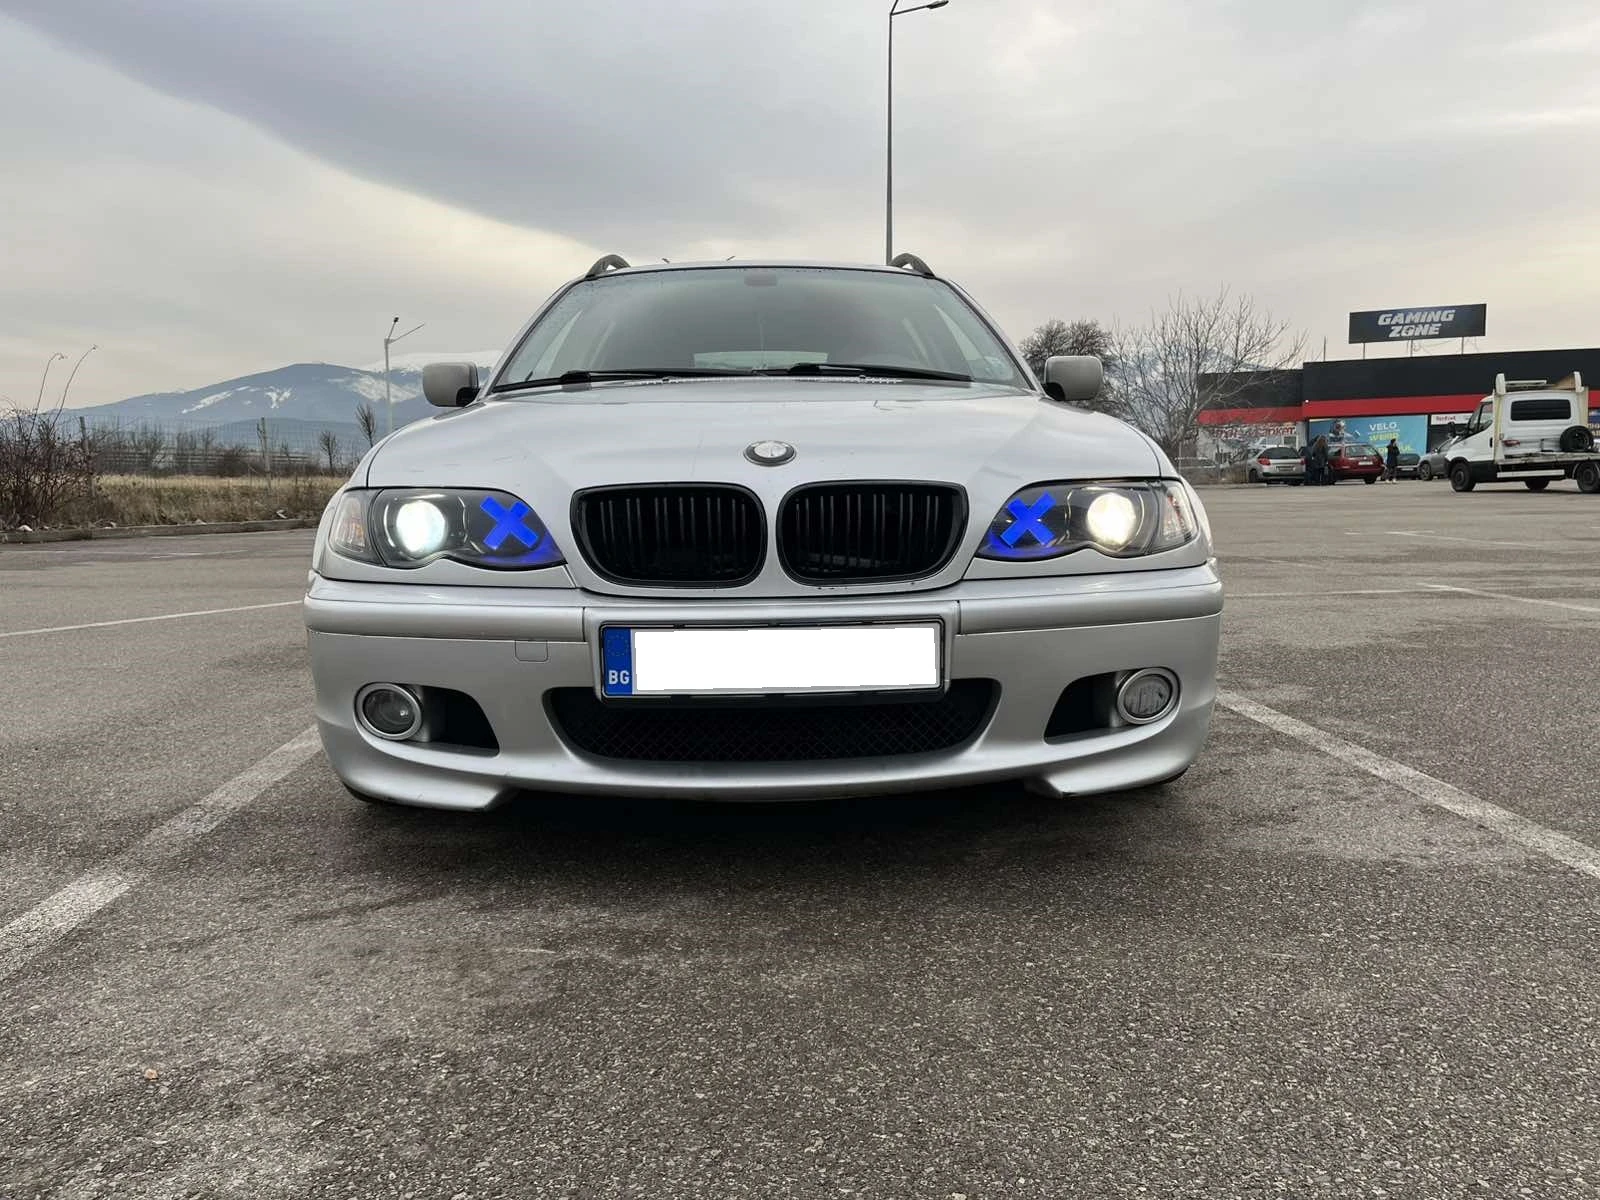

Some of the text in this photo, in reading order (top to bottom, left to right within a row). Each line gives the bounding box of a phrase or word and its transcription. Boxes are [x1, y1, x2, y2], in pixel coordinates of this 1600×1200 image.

[1378, 310, 1456, 325] GAMING
[1388, 323, 1441, 338] ZONE
[1369, 422, 1397, 431] VELO
[608, 670, 630, 685] BG
